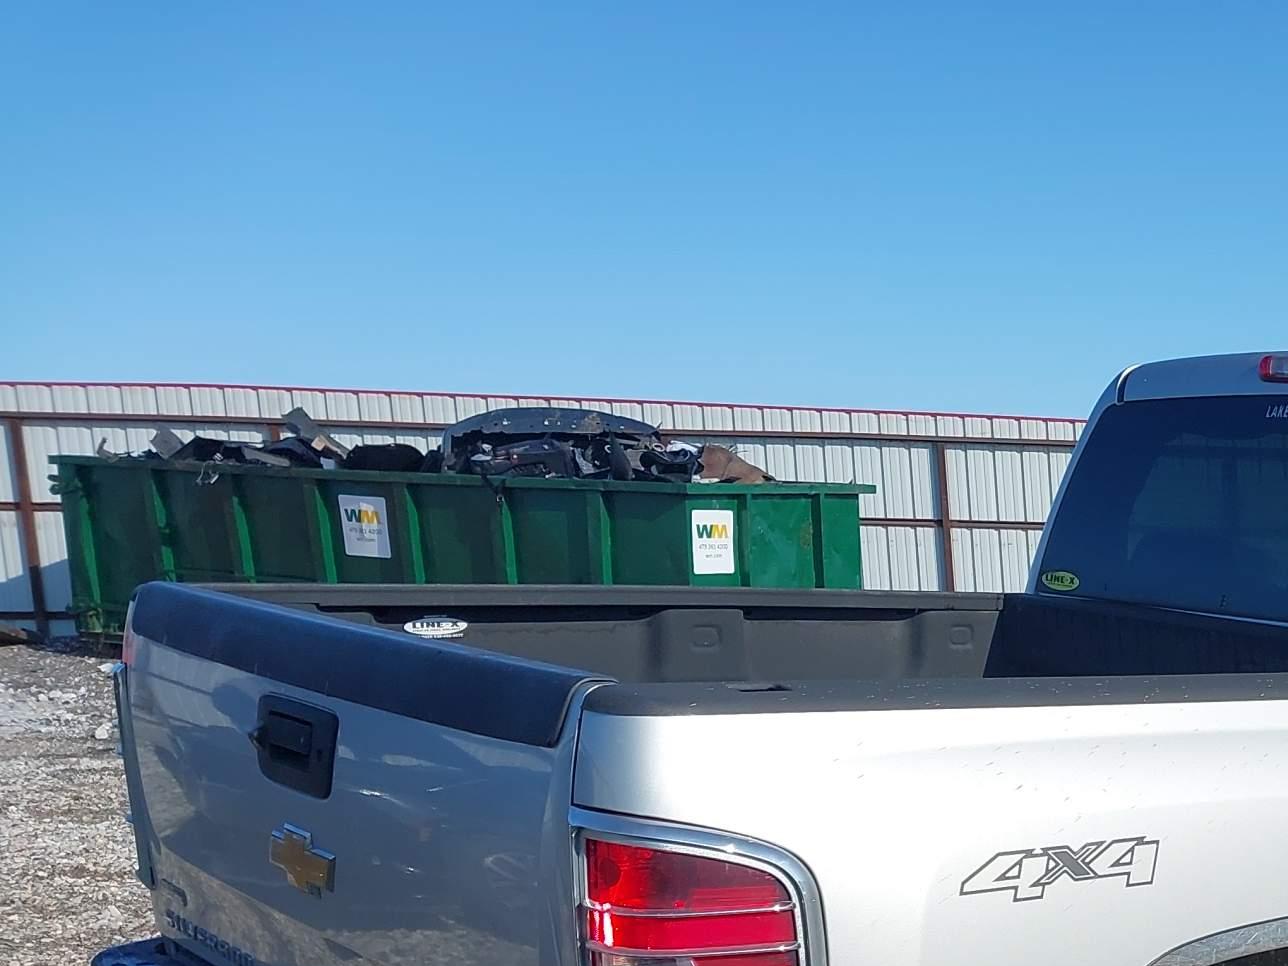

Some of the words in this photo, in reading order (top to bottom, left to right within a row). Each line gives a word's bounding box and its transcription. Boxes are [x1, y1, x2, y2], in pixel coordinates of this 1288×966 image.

[343, 508, 381, 525] WM
[696, 523, 729, 539] WM
[1045, 573, 1076, 585] LINE-X
[411, 620, 461, 629] LINE-X
